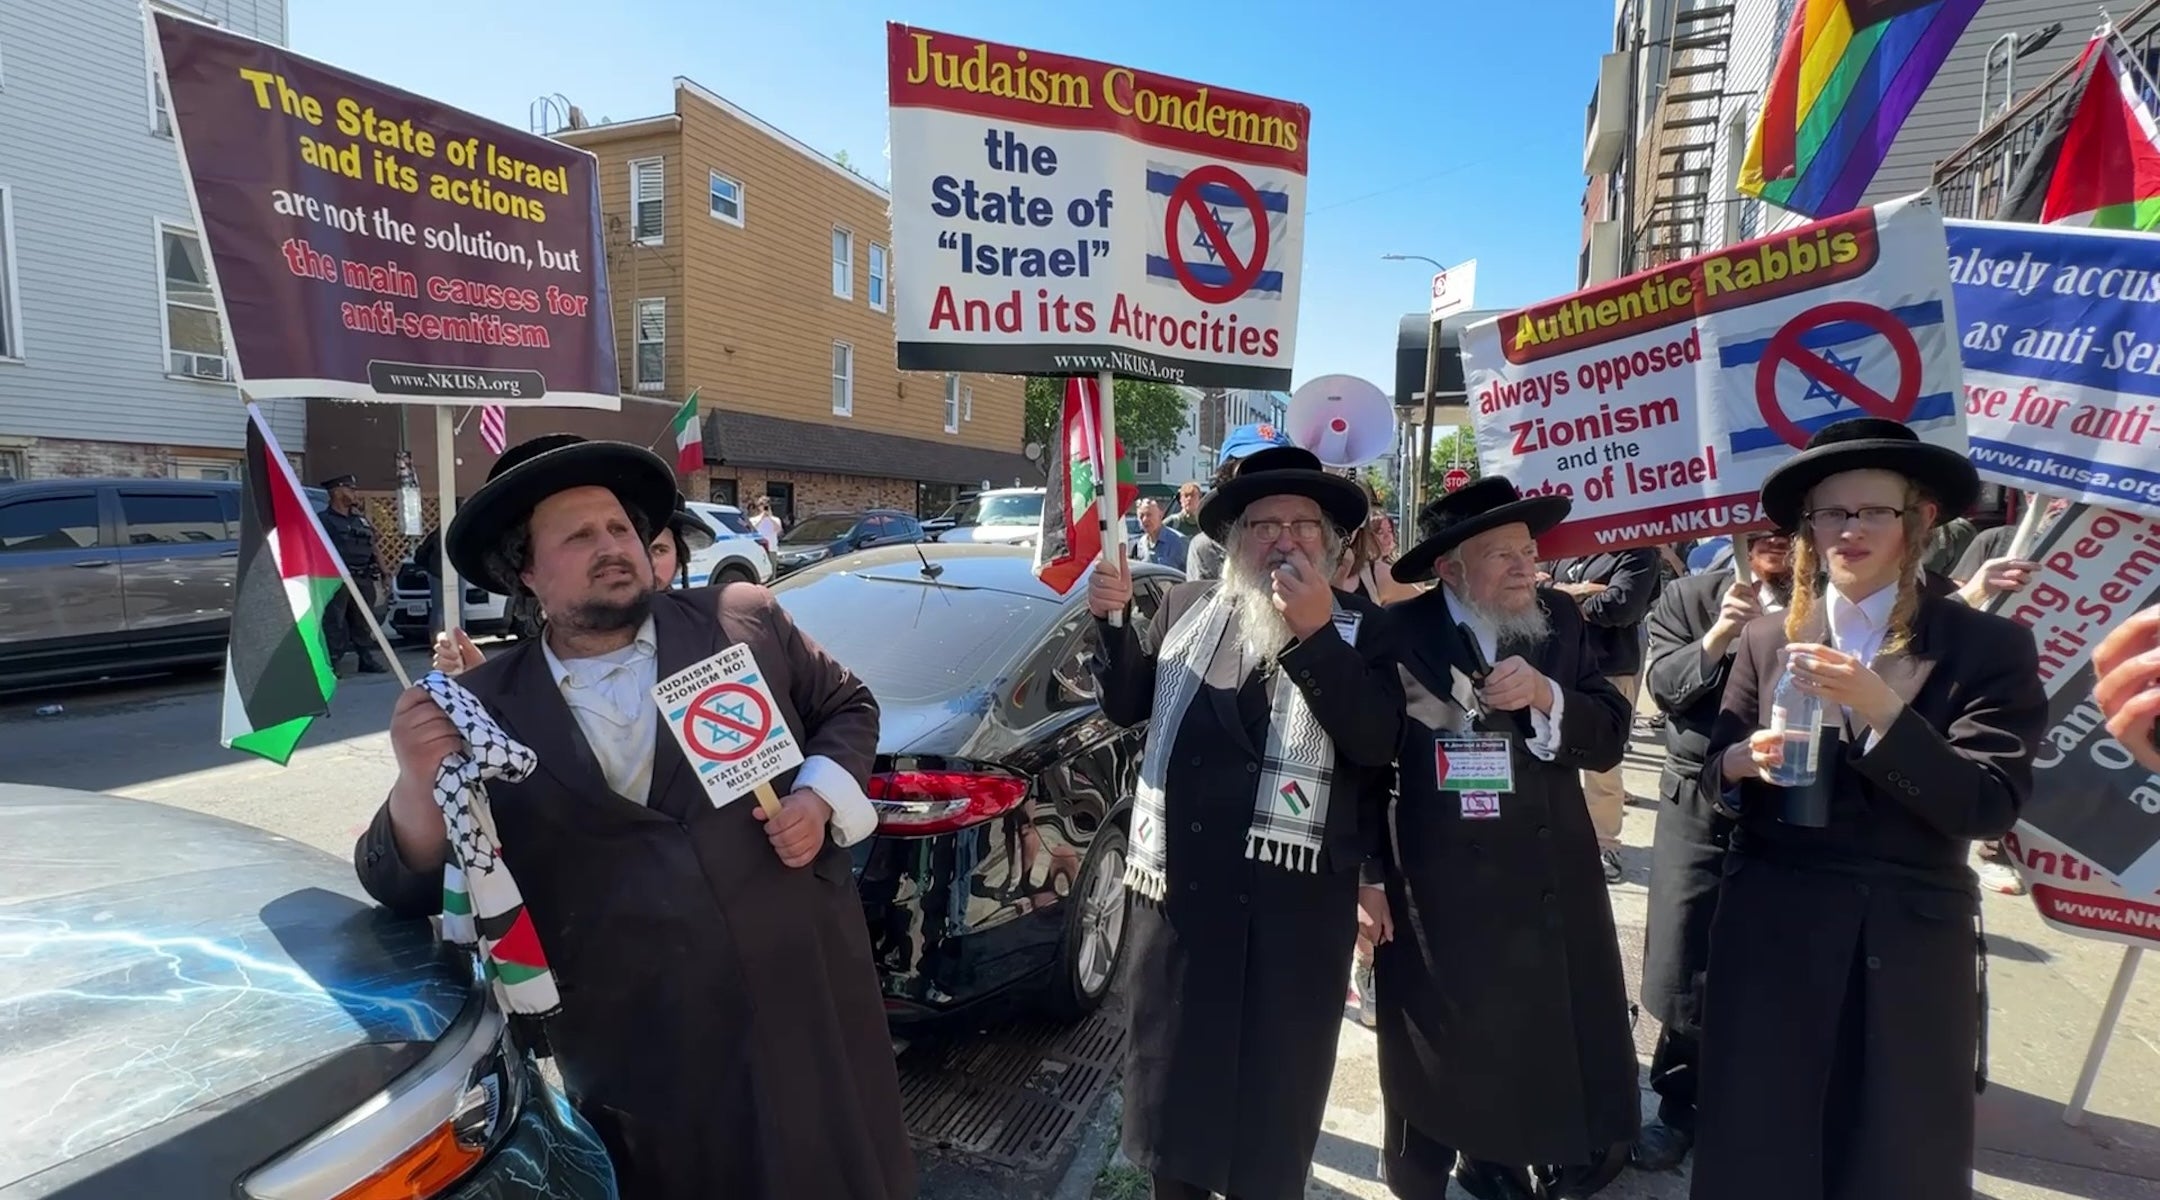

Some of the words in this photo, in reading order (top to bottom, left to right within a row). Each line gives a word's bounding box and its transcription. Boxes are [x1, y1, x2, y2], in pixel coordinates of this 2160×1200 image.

[906, 33, 1094, 109] Judaism
[1102, 67, 1298, 153] Condemns
[240, 68, 323, 126] The
[336, 97, 436, 158] State
[446, 137, 479, 170] of
[486, 144, 569, 196] Israel
[984, 129, 1058, 176] the
[299, 134, 363, 180] and
[373, 154, 419, 194] its
[430, 172, 548, 224] actions
[931, 176, 1054, 227] State
[1067, 189, 1113, 228] of
[271, 189, 320, 222] are
[323, 201, 370, 236] not
[372, 207, 417, 245] the
[423, 222, 533, 272] solution,
[537, 239, 581, 273] but
[937, 230, 1110, 277] “Israel”
[281, 237, 338, 283] the
[342, 258, 419, 298] main
[426, 275, 541, 314] causes
[546, 285, 588, 318] for
[1512, 274, 1694, 351] Authentic
[1703, 227, 1859, 297] Rabbis
[1946, 247, 2050, 297] alsely
[341, 300, 551, 349] anti-semitism
[929, 286, 1023, 333] And
[1038, 288, 1096, 334] its
[1109, 293, 1280, 358] Atrocities
[1963, 320, 2009, 352] as
[389, 372, 522, 396] www.NKUSA.org
[1054, 350, 1185, 383] www.NKUSA.org
[1479, 366, 1570, 415] always
[1576, 325, 1701, 392] opposed
[1509, 396, 1679, 456] Zionism
[2008, 385, 2070, 429] for
[1557, 447, 1598, 472] and
[1602, 442, 1640, 462] the
[1583, 461, 1614, 502] of
[1625, 446, 1717, 495] Israel
[657, 663, 714, 696] JUDAISM
[715, 649, 745, 666] YES!
[664, 672, 720, 704] ZIONISM
[723, 660, 746, 676] NO!
[707, 766, 740, 787] STATE
[741, 754, 755, 769] OF
[756, 740, 791, 761] ISRAEL
[726, 769, 758, 789] MUST
[762, 754, 782, 770] GO!
